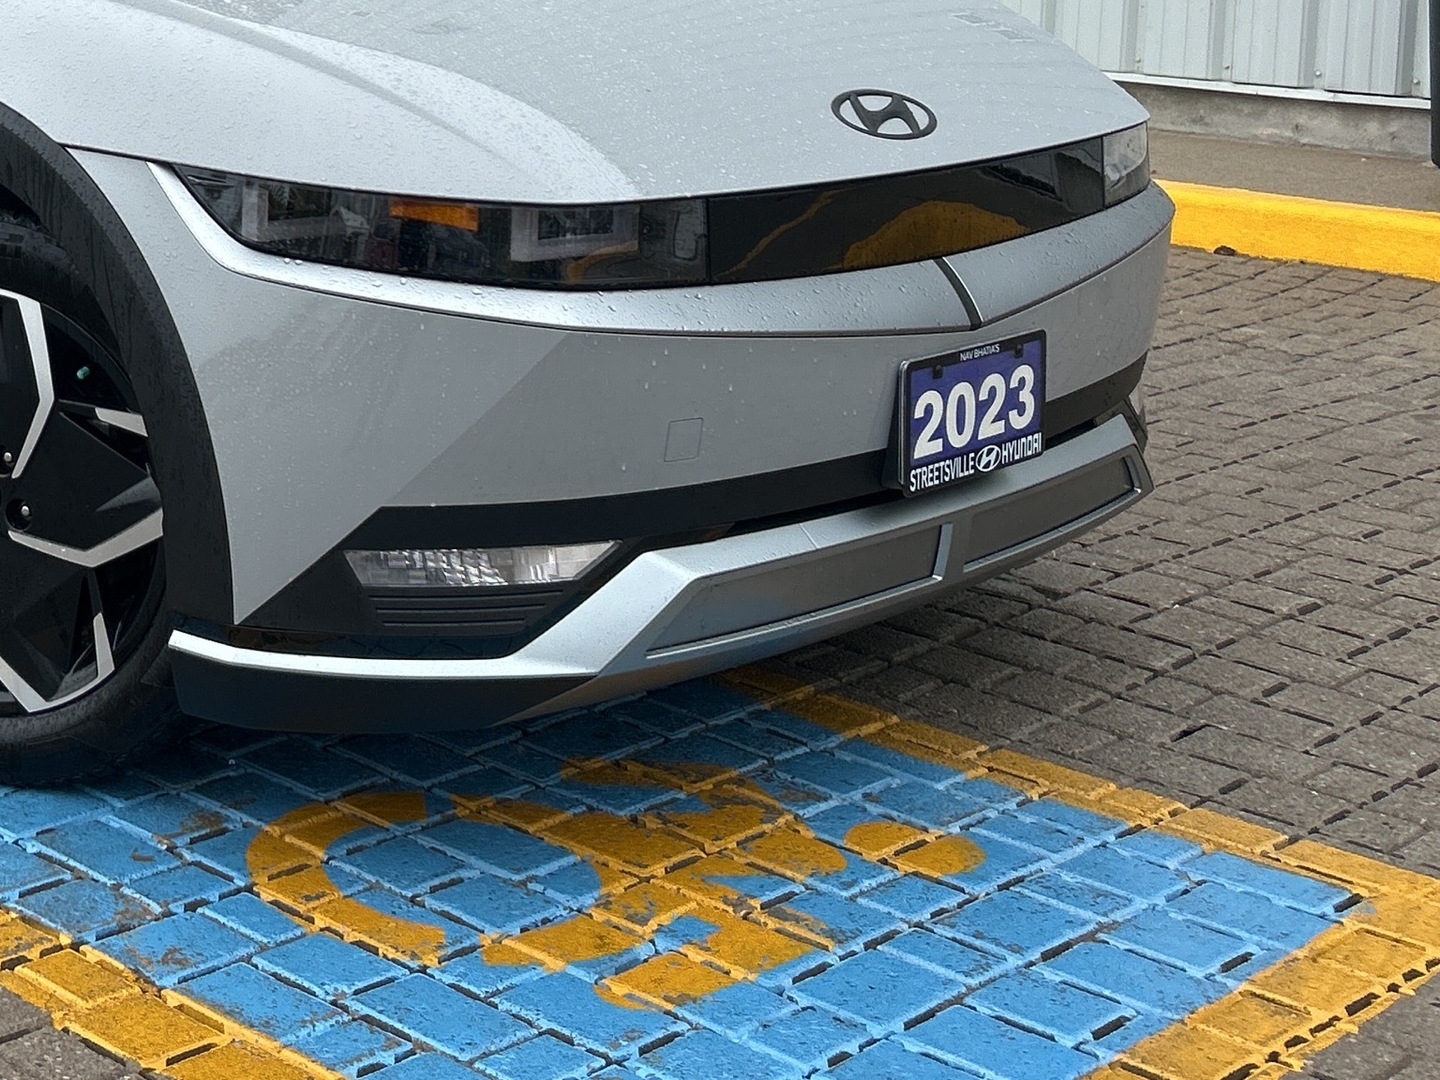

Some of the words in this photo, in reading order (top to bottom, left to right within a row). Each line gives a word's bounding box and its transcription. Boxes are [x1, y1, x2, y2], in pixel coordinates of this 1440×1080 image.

[959, 349, 973, 362] NAV
[913, 364, 1035, 460] 2023
[909, 452, 975, 493] STREETSVILLE
[1001, 432, 1042, 465] HYUNDAI
